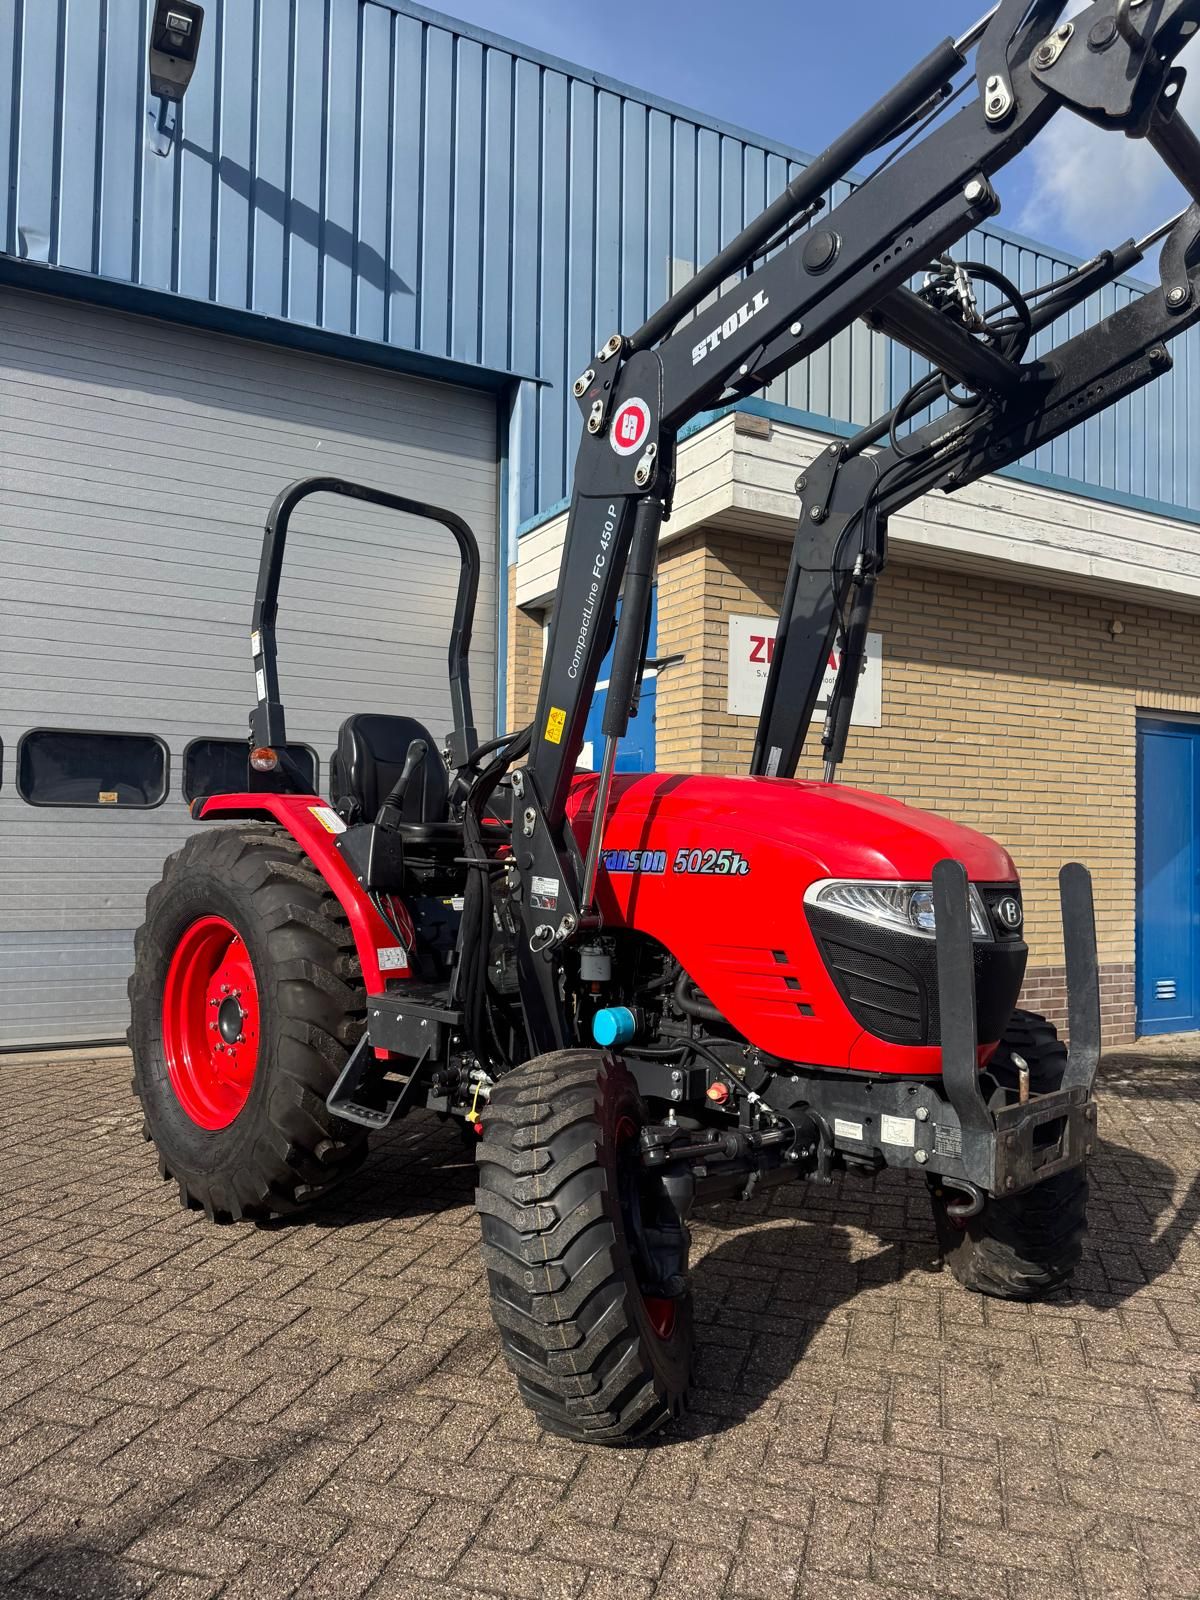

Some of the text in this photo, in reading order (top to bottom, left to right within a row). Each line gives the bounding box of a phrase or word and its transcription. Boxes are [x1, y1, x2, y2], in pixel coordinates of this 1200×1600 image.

[691, 289, 769, 366] STOLL
[567, 503, 619, 680] CompactLine FC 450 P
[597, 848, 751, 876] ranson 5025h
[1005, 902, 1017, 923] B
